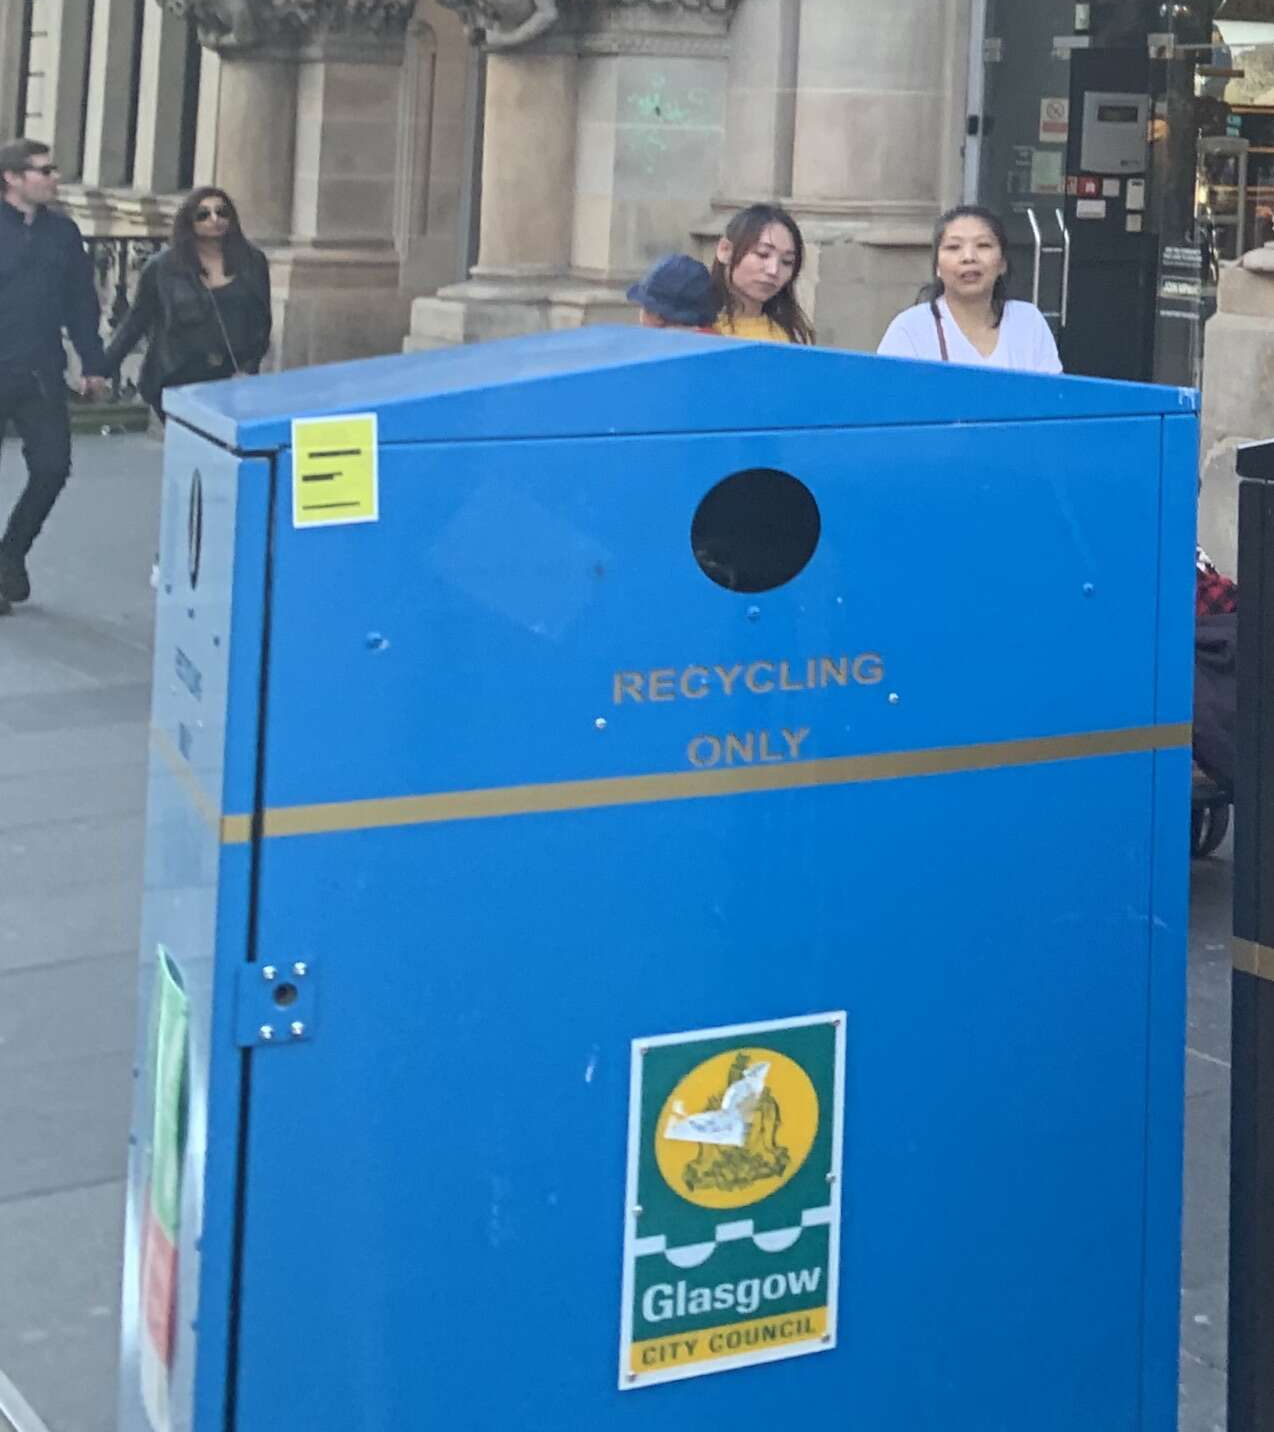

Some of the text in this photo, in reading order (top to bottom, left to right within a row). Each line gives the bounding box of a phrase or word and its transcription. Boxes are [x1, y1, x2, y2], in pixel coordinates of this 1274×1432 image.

[613, 652, 883, 704] RECYCLING
[688, 727, 809, 768] ONLY
[642, 1267, 822, 1323] Glasgow
[642, 1316, 816, 1367] CITY COUNCIL
